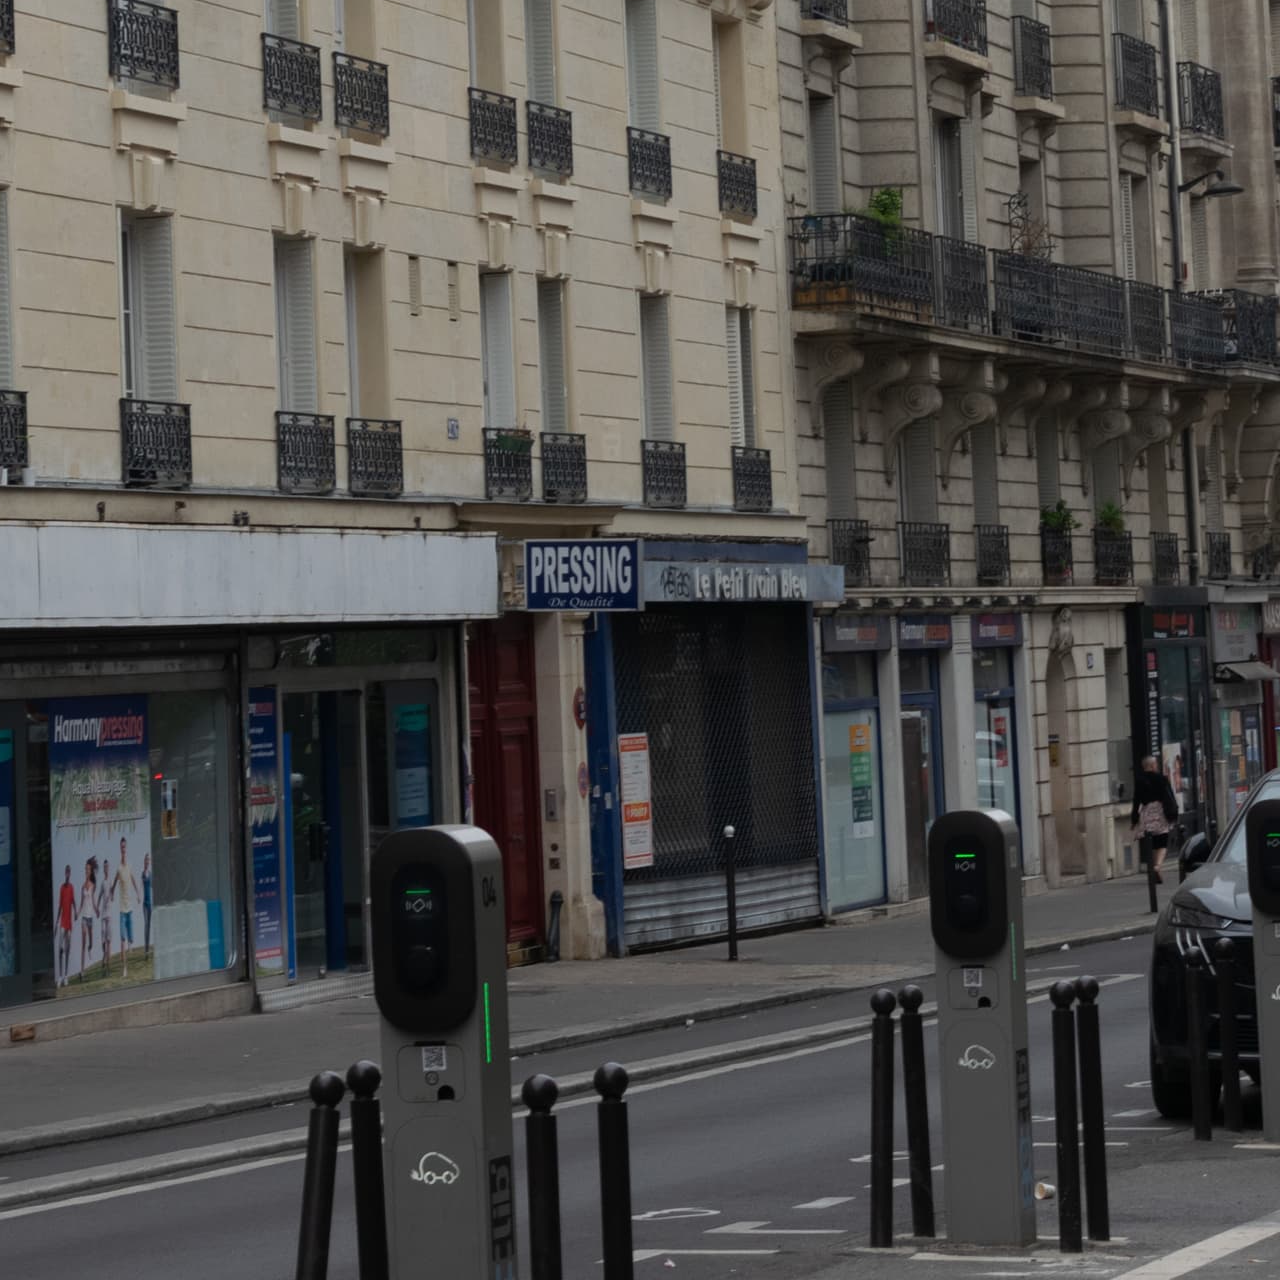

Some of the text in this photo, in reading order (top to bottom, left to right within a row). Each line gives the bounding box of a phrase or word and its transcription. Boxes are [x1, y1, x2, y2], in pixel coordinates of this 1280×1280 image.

[531, 545, 632, 595] PRESSING
[695, 568, 711, 599] Le
[714, 567, 744, 600] Petit
[747, 568, 778, 599] Train
[781, 568, 808, 599] Bleu
[548, 596, 614, 608] De Qualité
[54, 708, 144, 748] Harmonypressing
[482, 877, 497, 909] 04
